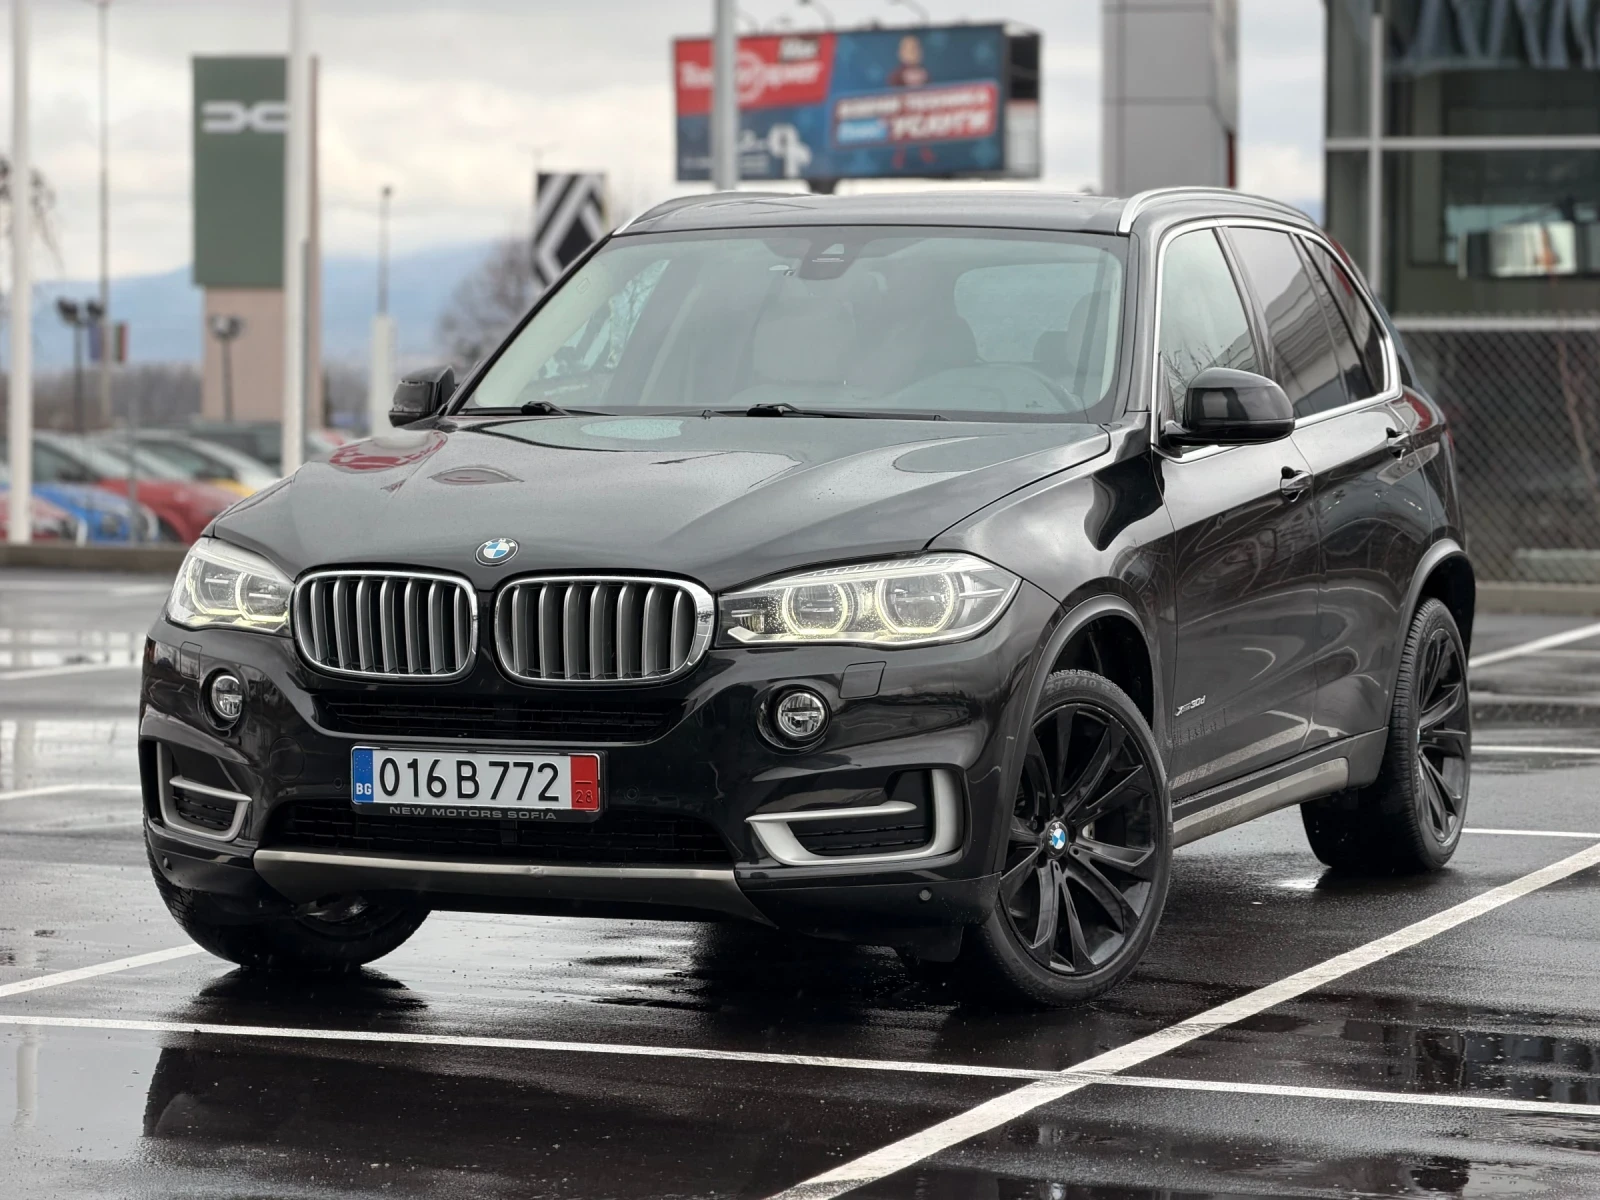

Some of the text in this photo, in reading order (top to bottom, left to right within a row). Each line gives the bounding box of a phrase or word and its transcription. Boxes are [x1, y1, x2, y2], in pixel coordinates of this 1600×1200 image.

[379, 757, 560, 802] 016B772
[355, 783, 372, 795] BG
[575, 789, 593, 804] 28
[389, 806, 557, 820] NEW MOTORS SOFIA
